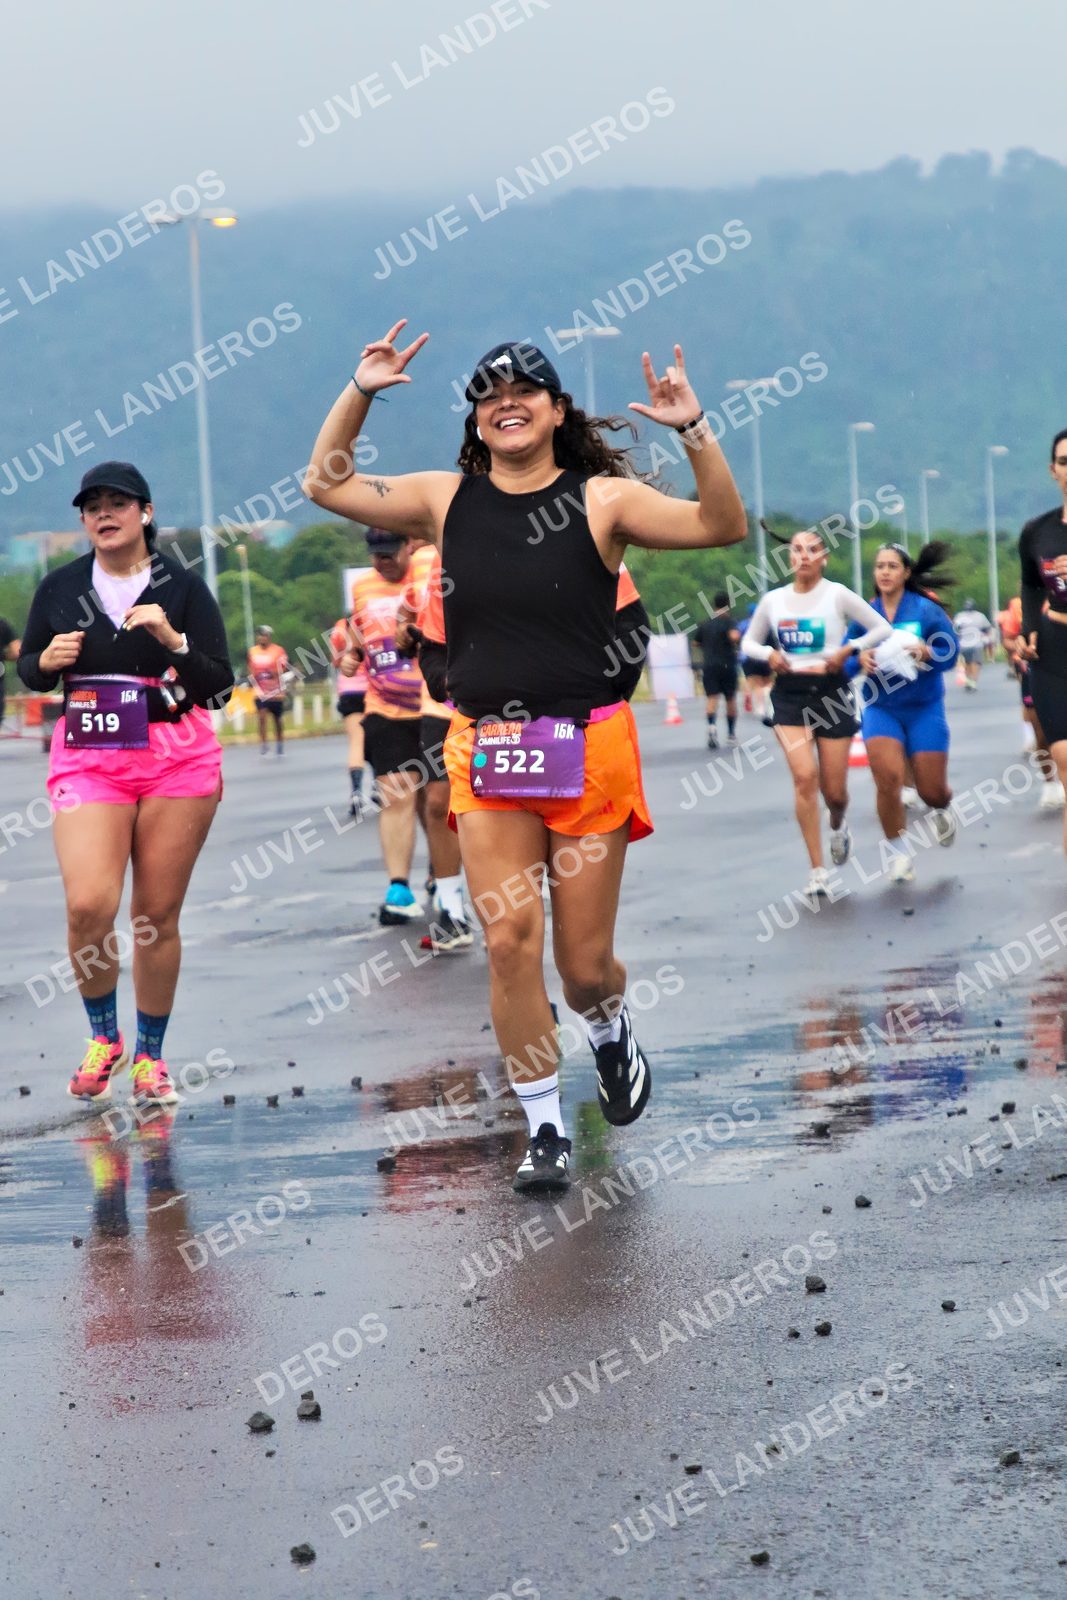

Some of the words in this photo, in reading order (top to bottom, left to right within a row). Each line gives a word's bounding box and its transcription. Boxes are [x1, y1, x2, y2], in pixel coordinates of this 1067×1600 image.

[81, 712, 120, 733] 519
[480, 722, 522, 737] CARRERA
[494, 749, 545, 774] 522
